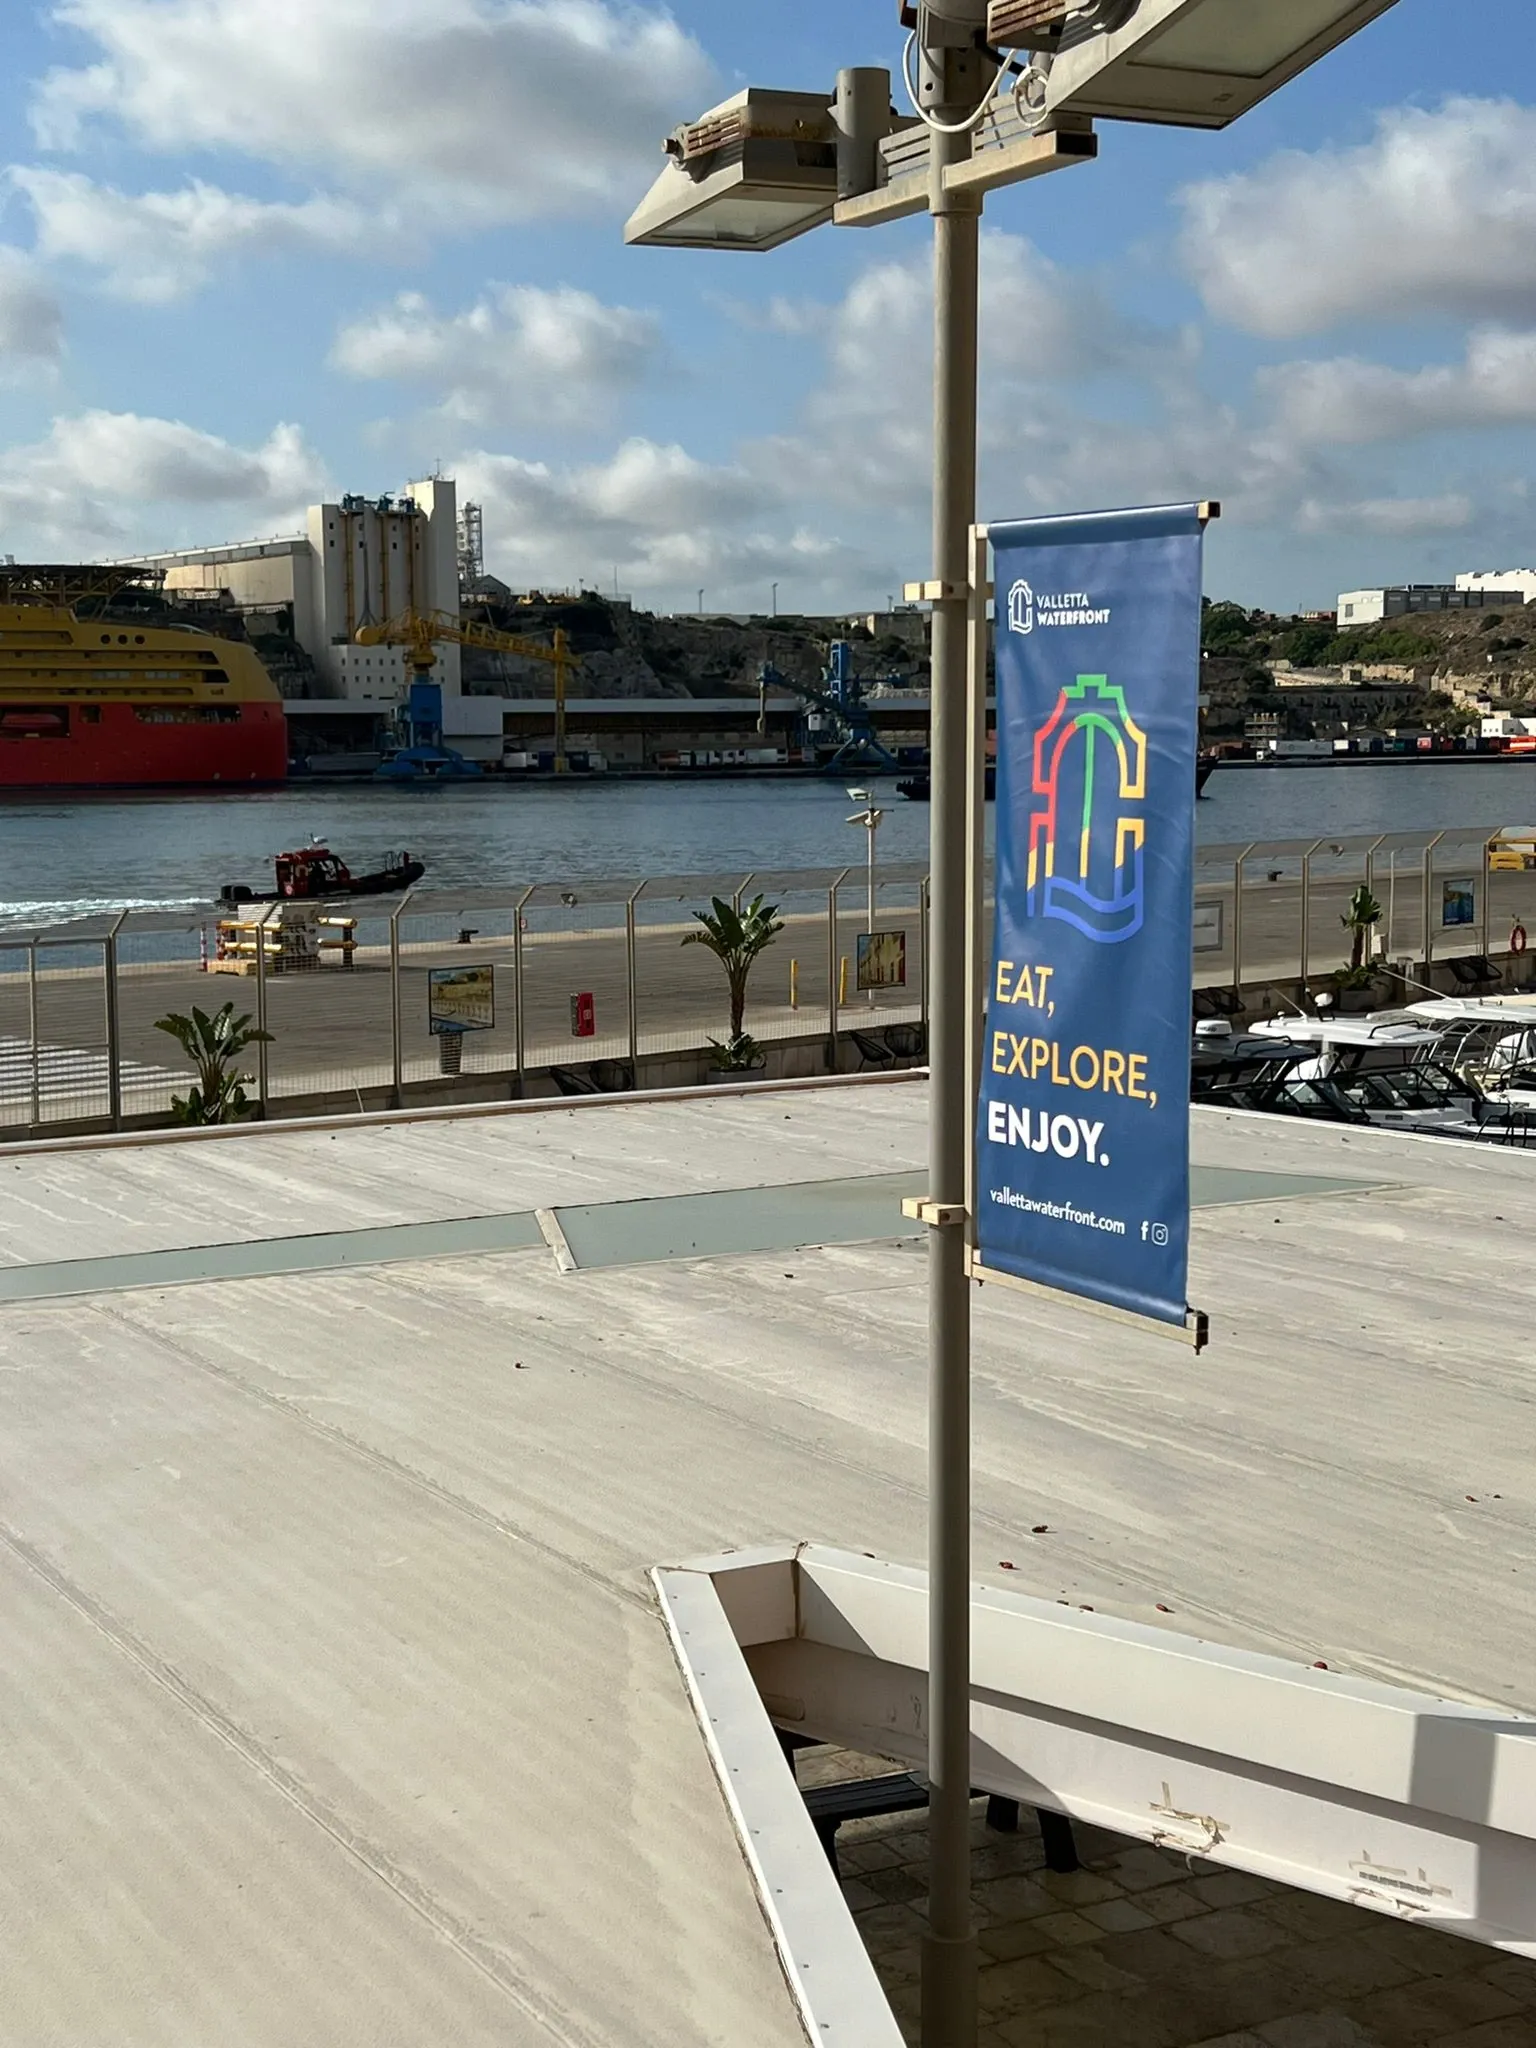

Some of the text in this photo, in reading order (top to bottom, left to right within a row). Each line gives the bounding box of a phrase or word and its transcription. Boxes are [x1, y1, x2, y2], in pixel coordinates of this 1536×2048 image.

[1036, 593, 1089, 609] VALLETTA
[1037, 609, 1110, 626] WATERFRONT
[996, 960, 1055, 1017] EAT,
[991, 1031, 1157, 1108] EXPLORE,
[988, 1101, 1110, 1166] ENJOY.
[990, 1187, 1125, 1235] vallettawaterfront.com
